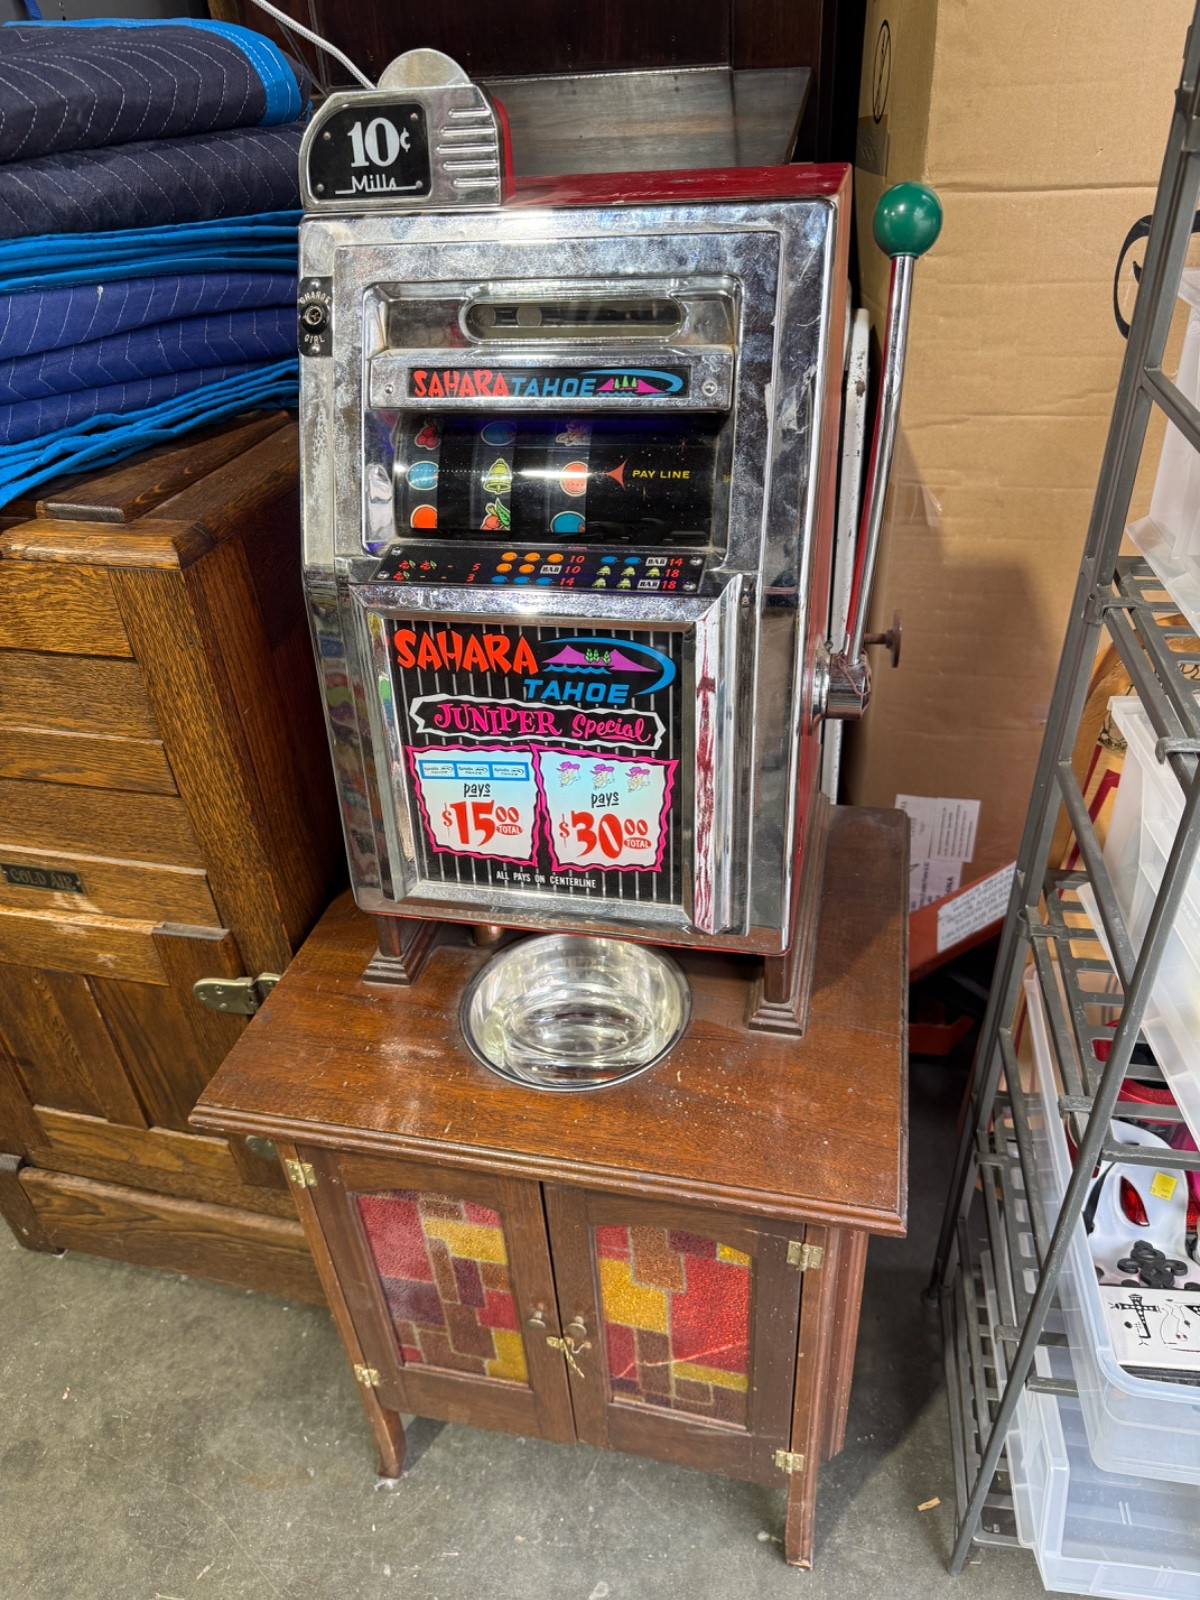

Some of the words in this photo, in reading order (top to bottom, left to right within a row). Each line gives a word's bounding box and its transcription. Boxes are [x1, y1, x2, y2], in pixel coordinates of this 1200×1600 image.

[347, 117, 411, 167] 10¢
[350, 174, 398, 193] Mills
[414, 369, 509, 397] SAHARA
[511, 378, 596, 397] TAHOE
[632, 470, 656, 478] PAY
[660, 470, 691, 479] LINE
[570, 555, 585, 564] 10
[646, 557, 667, 566] BAR
[669, 558, 683, 567] 14
[472, 563, 481, 571] 5
[541, 565, 561, 574] BAR
[564, 566, 581, 574] 10
[467, 574, 476, 583] 3
[665, 569, 680, 578] 18
[559, 577, 575, 586] 14
[638, 579, 659, 589] BAR
[662, 580, 677, 590] 18
[394, 629, 539, 675] SAHARA
[523, 679, 630, 704] TAHOE
[434, 703, 563, 736] JUNIPER
[571, 713, 652, 743] Special
[463, 783, 491, 798] pays
[591, 792, 620, 808] pays
[498, 825, 521, 834] TOTAL
[625, 839, 650, 849] TOTAL
[10, 868, 47, 886] COLD
[51, 871, 77, 891] AIR
[496, 871, 510, 880] ALL
[513, 872, 531, 882] PAYS
[534, 874, 546, 884] ON
[549, 876, 597, 889] CENTERLINE
